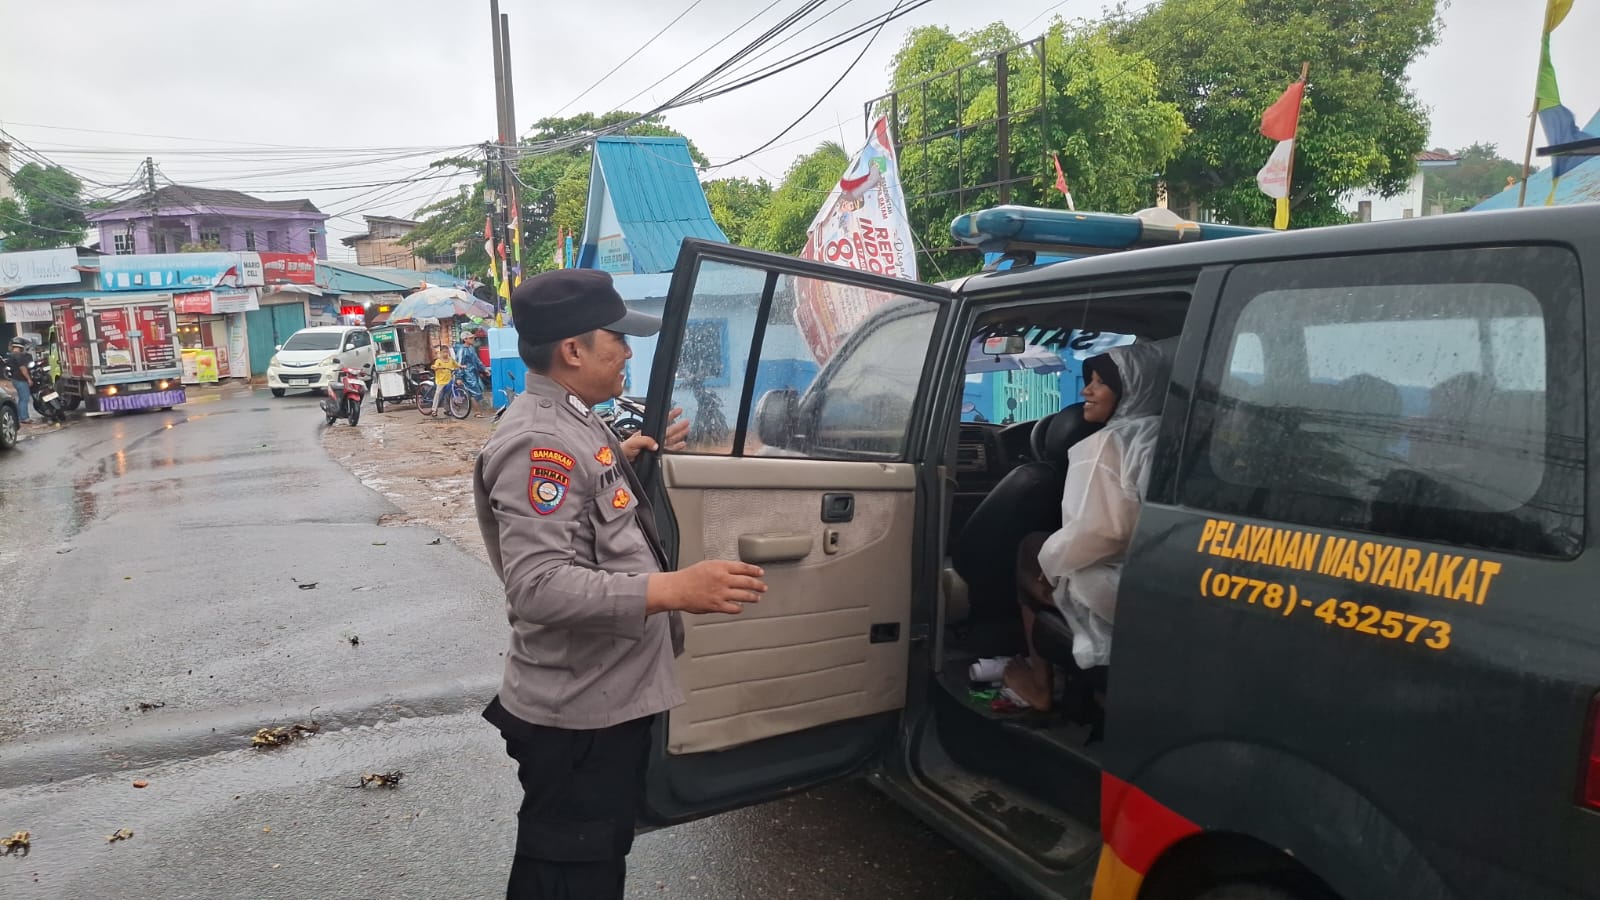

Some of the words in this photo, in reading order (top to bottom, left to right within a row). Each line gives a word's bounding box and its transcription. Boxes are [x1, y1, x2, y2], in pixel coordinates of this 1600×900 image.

[859, 217, 883, 275] INDO
[875, 227, 897, 278] REPU
[533, 450, 573, 467] BAHARKAN
[1197, 518, 1321, 571] PELAYANAN
[1318, 536, 1502, 605] MASYARAKAT
